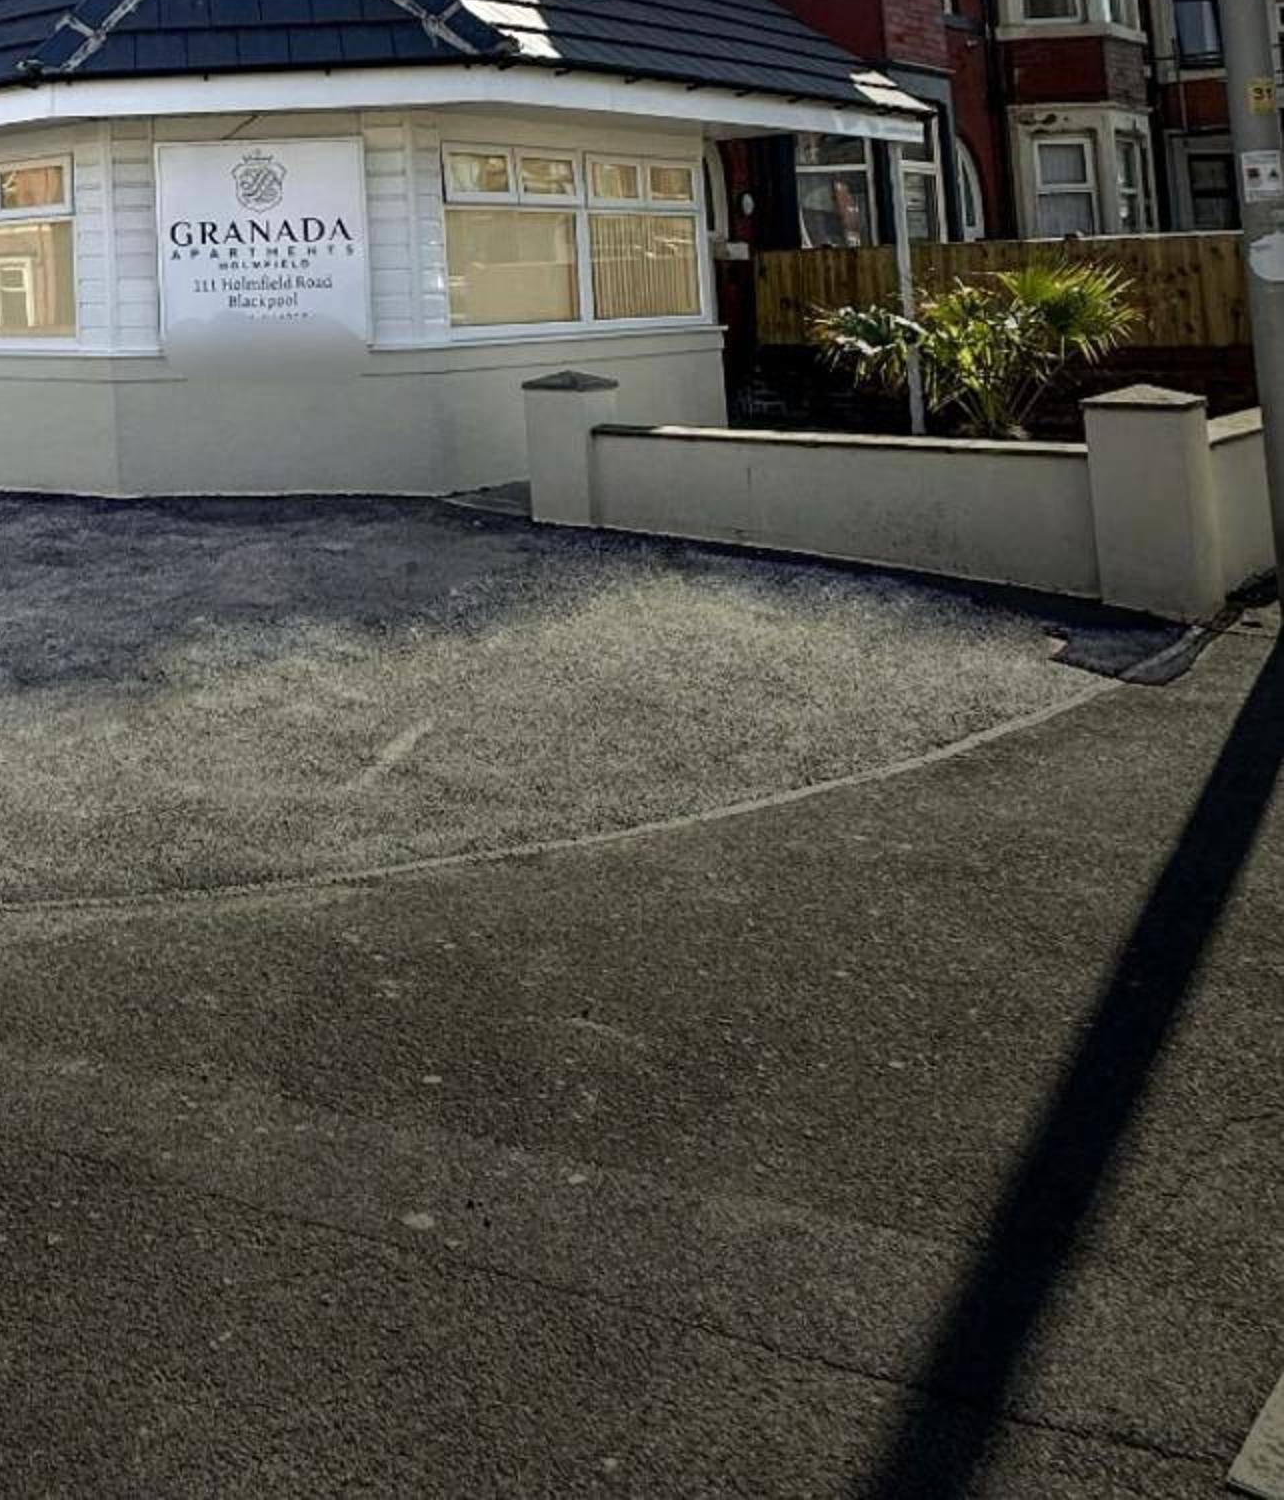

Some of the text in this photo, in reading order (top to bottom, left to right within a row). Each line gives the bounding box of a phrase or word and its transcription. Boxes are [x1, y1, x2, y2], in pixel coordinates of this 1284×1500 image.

[169, 217, 353, 247] GRANADA
[170, 245, 356, 261] APARTMENTS
[222, 276, 293, 291] Holmfield
[296, 274, 333, 289] Road
[228, 292, 299, 310] Blackpool
